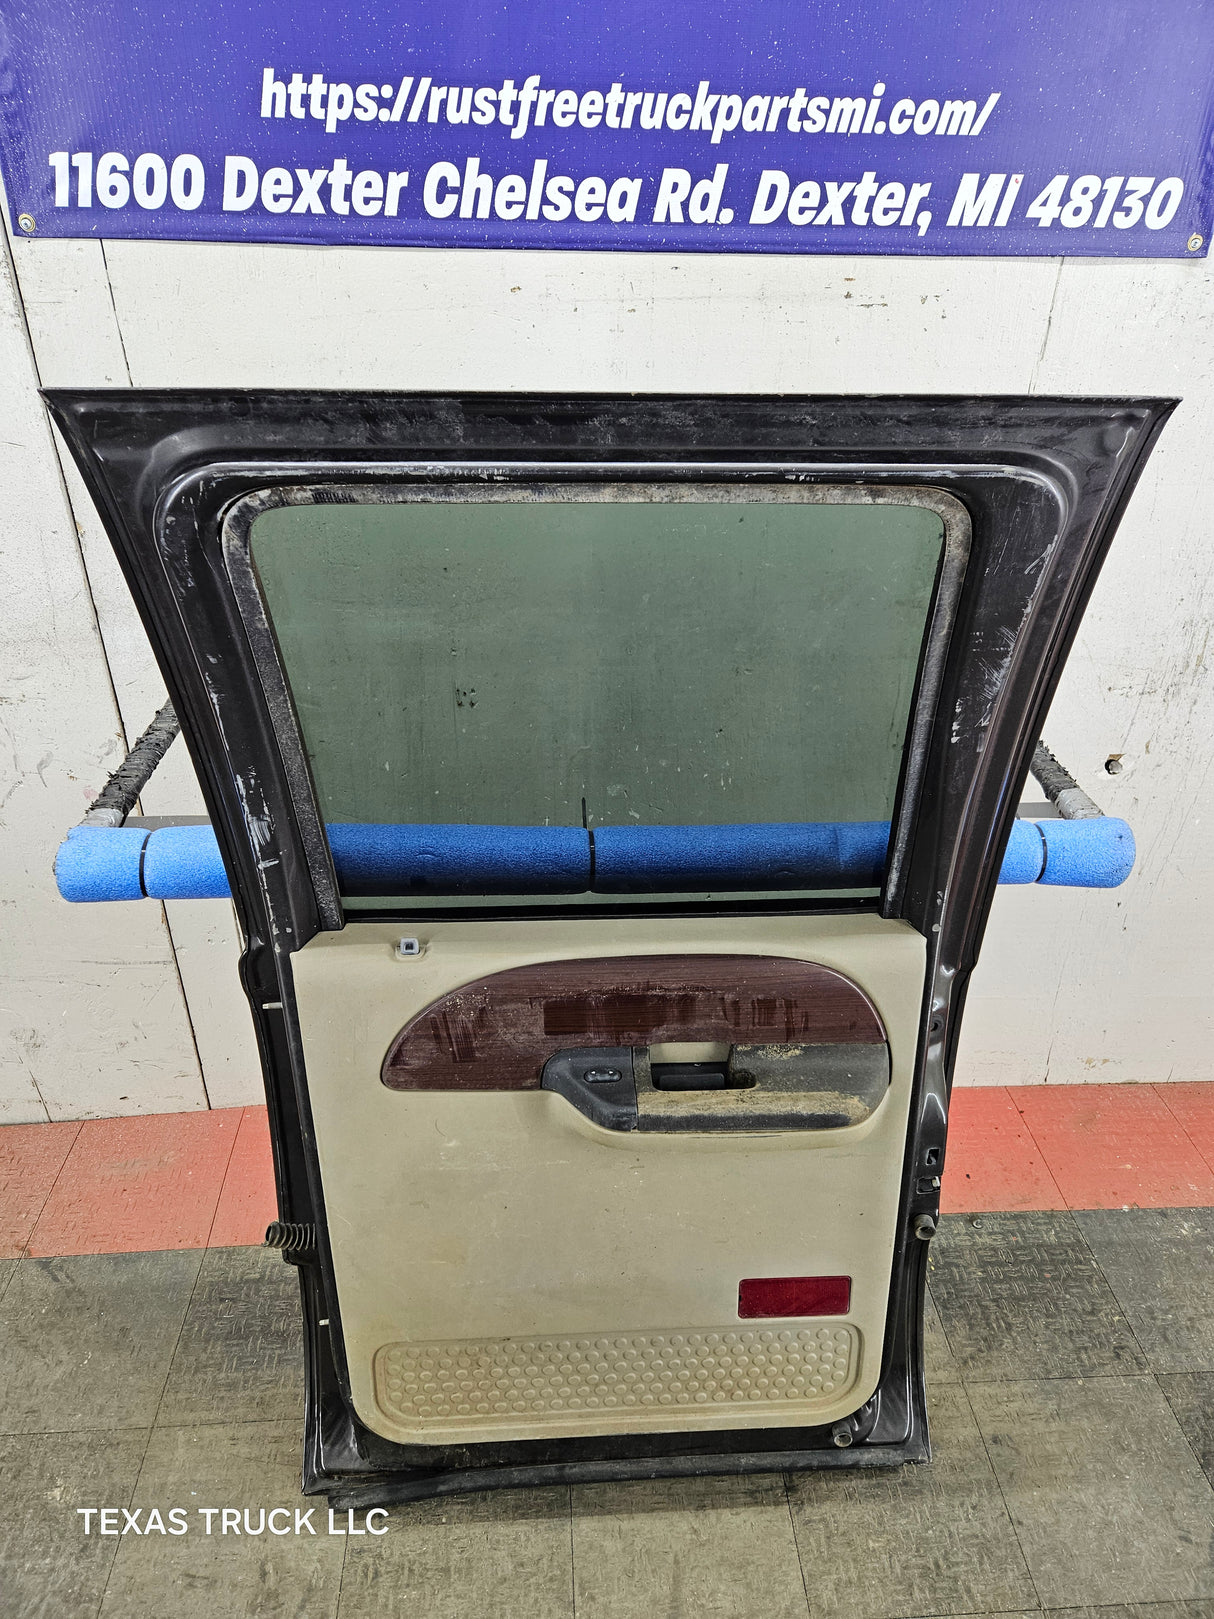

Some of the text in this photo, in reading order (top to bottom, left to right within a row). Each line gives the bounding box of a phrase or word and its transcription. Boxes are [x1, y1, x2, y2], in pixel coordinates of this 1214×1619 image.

[260, 67, 1002, 144] https://rustfreetruckpartsmi.com/
[48, 151, 1185, 236] 11600 Dexter Chelsea Rd. Dexter, MI 48130
